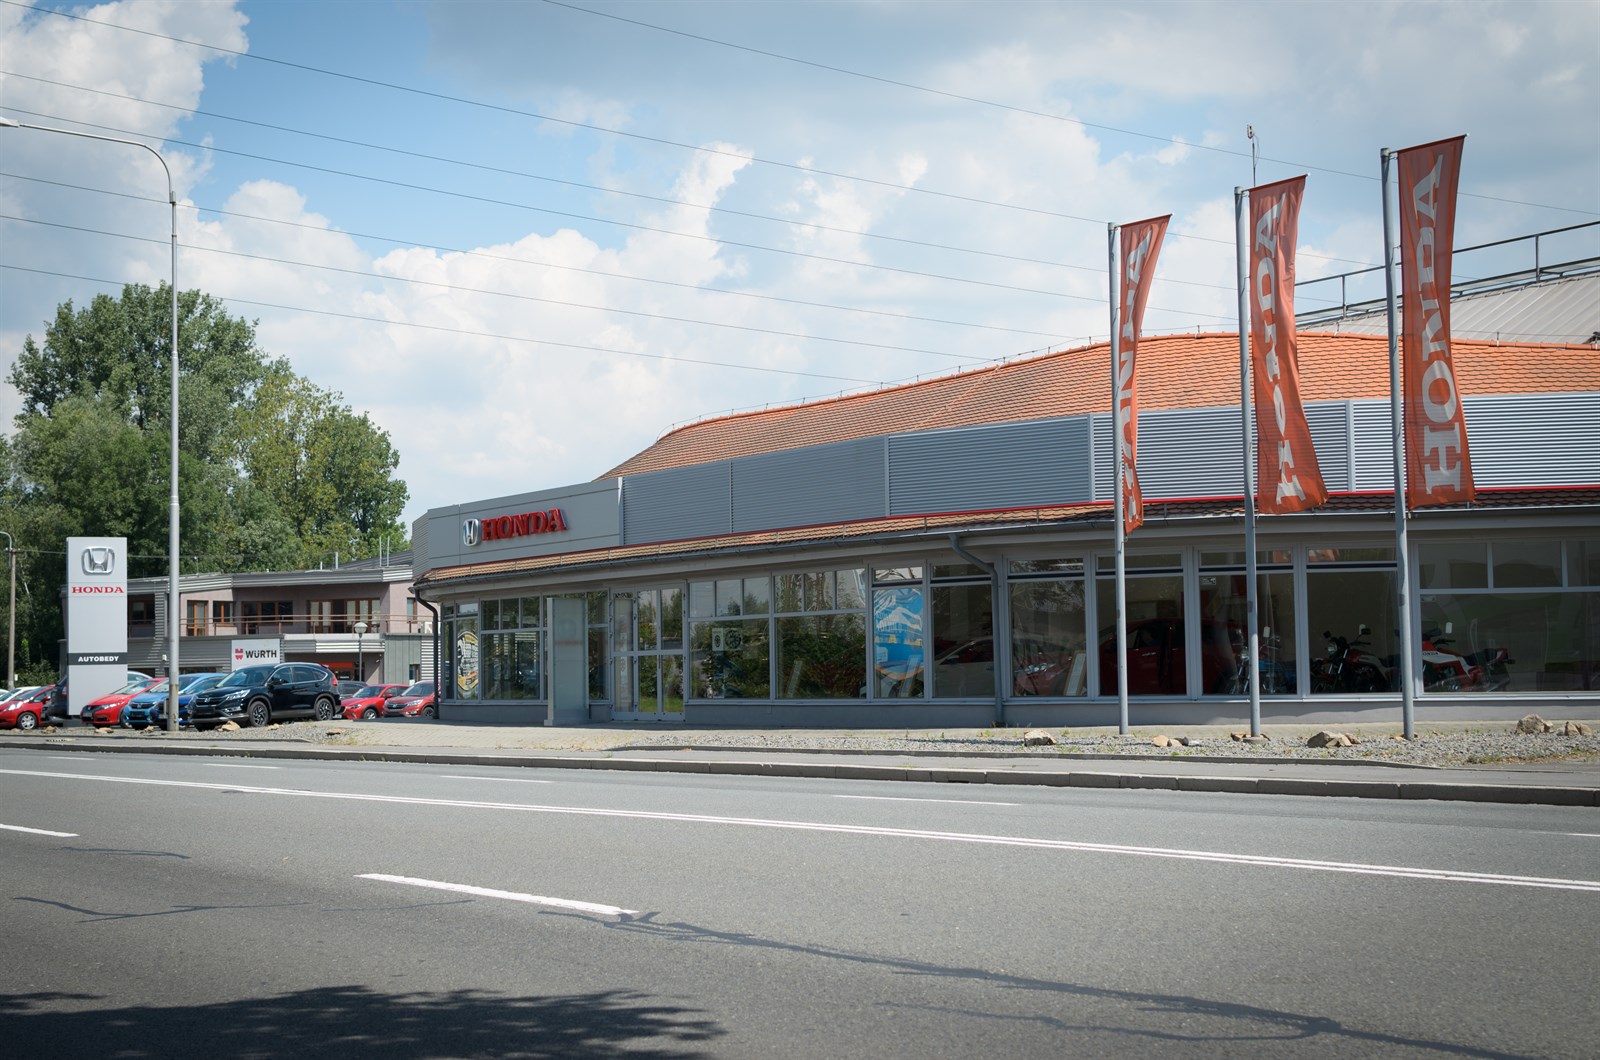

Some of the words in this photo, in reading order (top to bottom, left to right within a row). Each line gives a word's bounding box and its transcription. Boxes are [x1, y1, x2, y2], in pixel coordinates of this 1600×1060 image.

[1412, 154, 1461, 495] HONDA
[480, 508, 567, 541] HONDA
[71, 586, 124, 594] HONDA
[245, 649, 277, 659] WÜRTH
